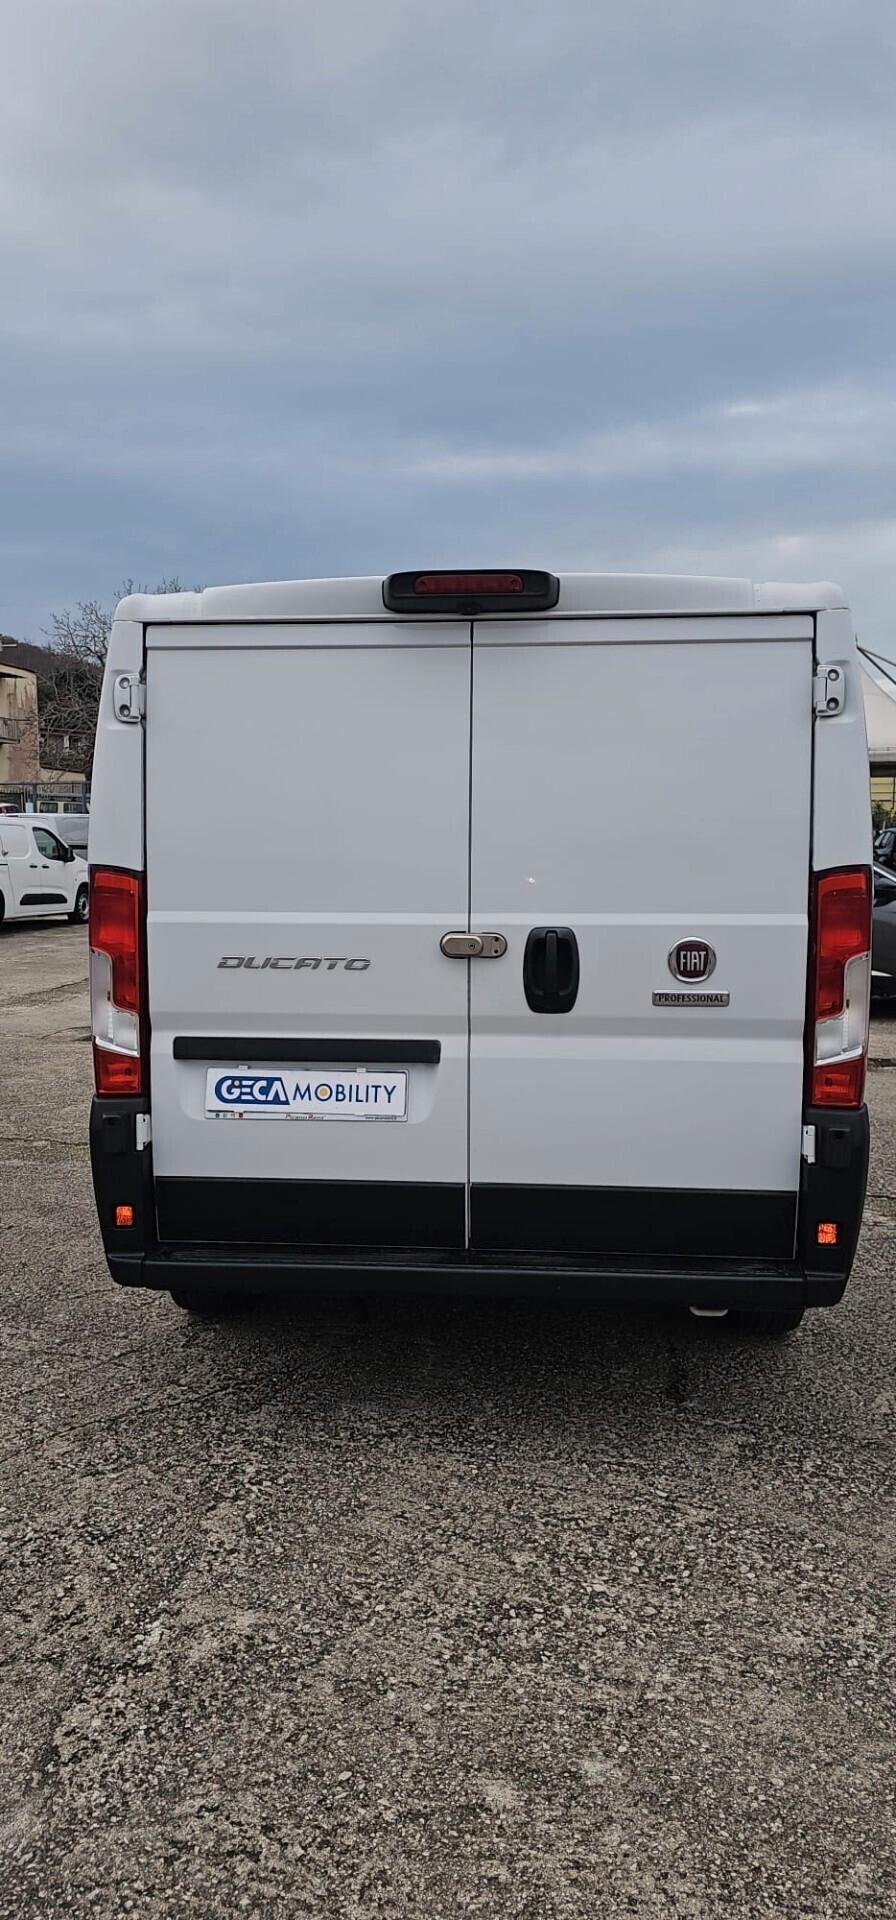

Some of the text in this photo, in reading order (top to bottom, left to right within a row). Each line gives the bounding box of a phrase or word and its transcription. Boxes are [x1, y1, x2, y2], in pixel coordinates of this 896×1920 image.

[216, 955, 372, 970] DUCATO
[680, 951, 706, 971] FIAT
[658, 992, 726, 1003] PROFESSIONAL
[220, 1079, 397, 1104] GECA MOBILITY
